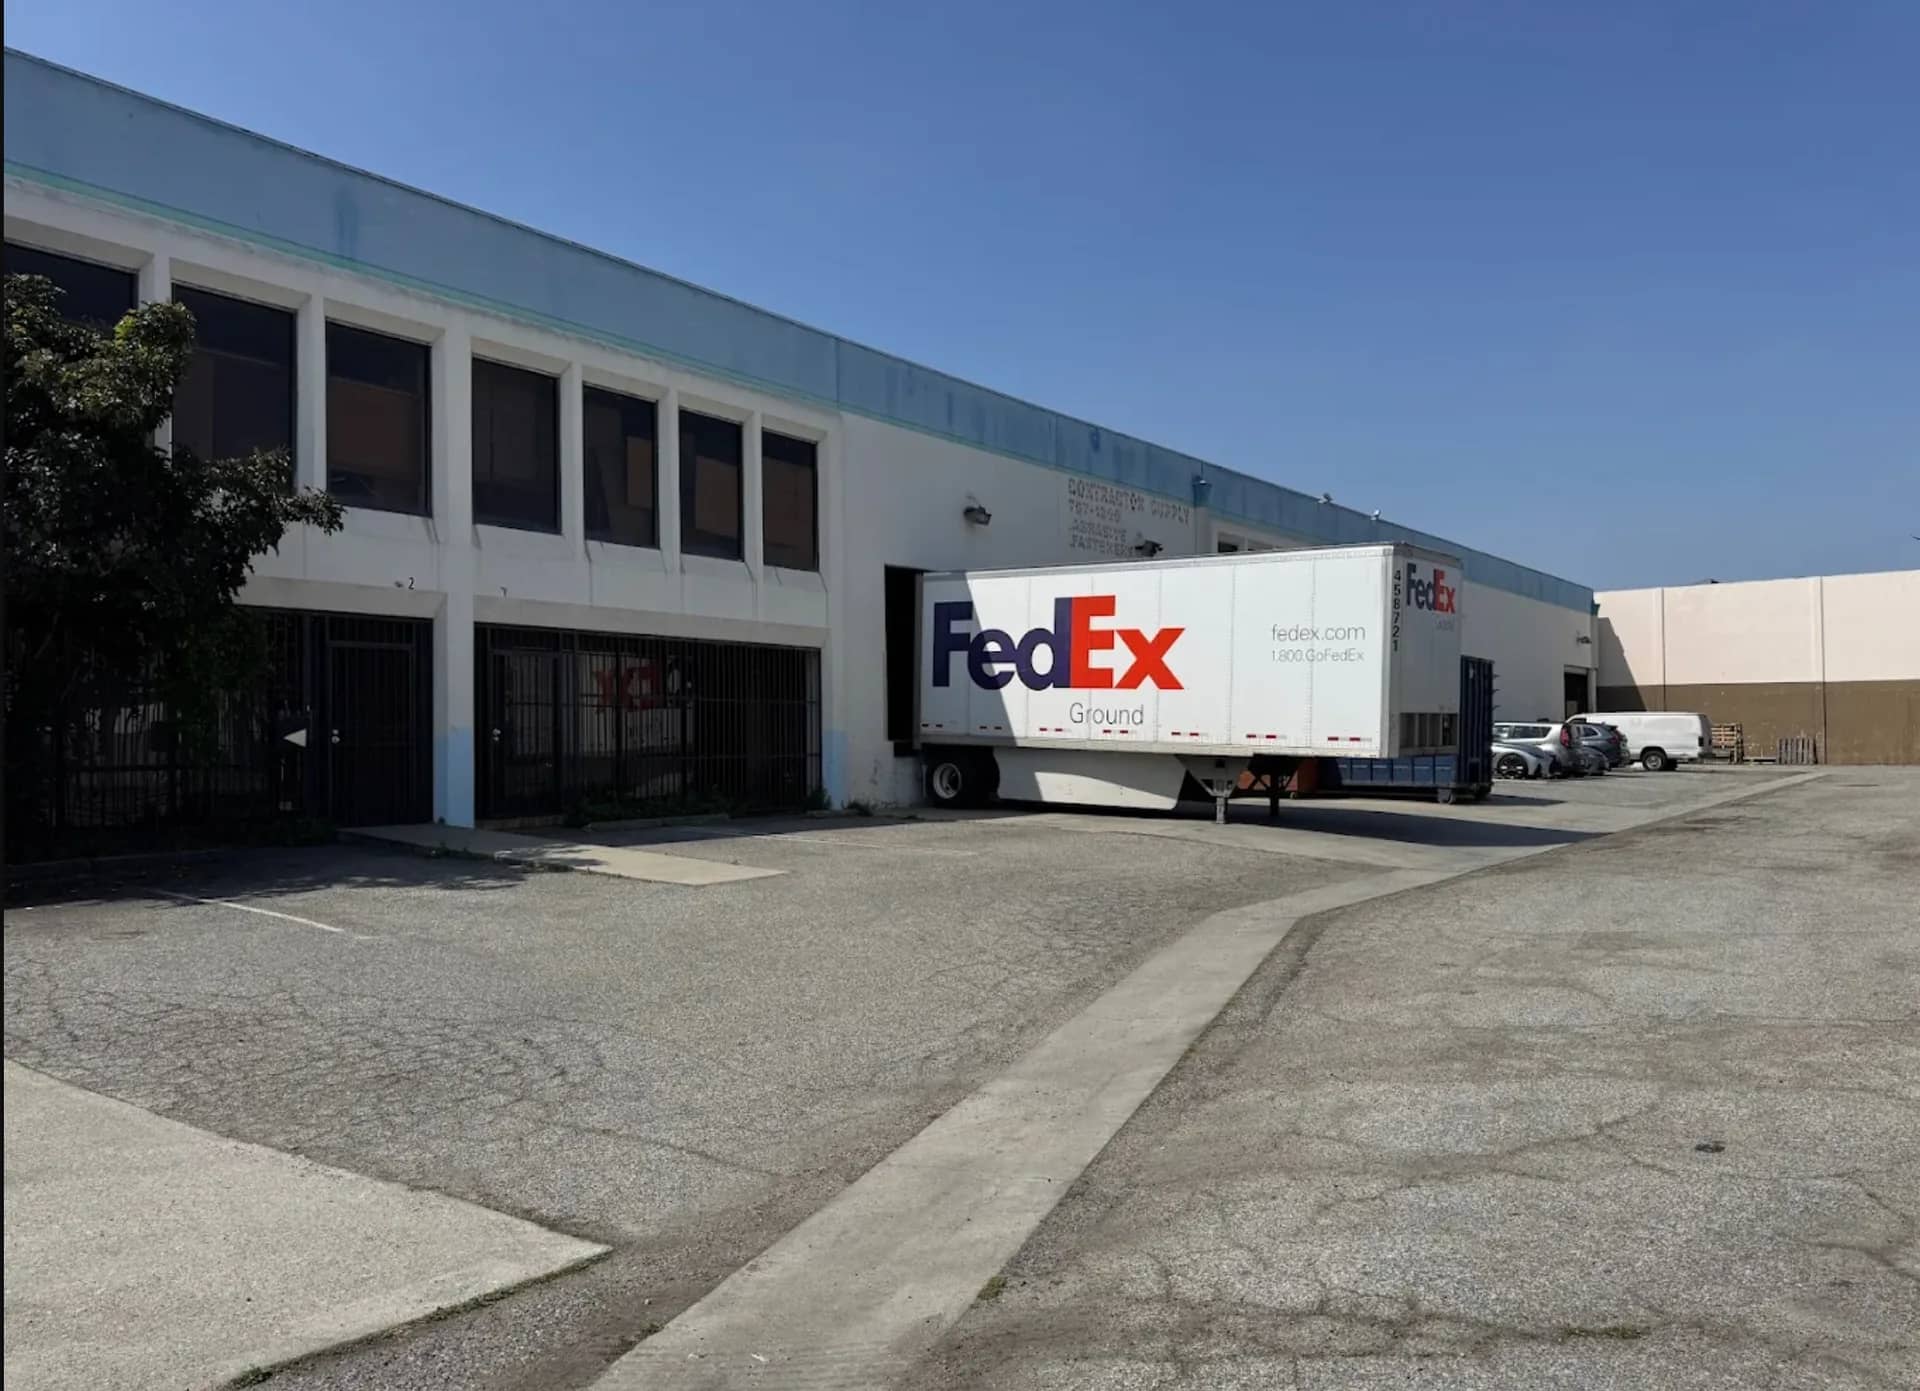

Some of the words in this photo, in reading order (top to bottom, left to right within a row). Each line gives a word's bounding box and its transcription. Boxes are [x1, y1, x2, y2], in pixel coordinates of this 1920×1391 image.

[1406, 562, 1456, 614] FedEx
[932, 595, 1186, 691] FedEx
[1272, 623, 1366, 641] fedex.com
[1069, 702, 1144, 725] Ground
